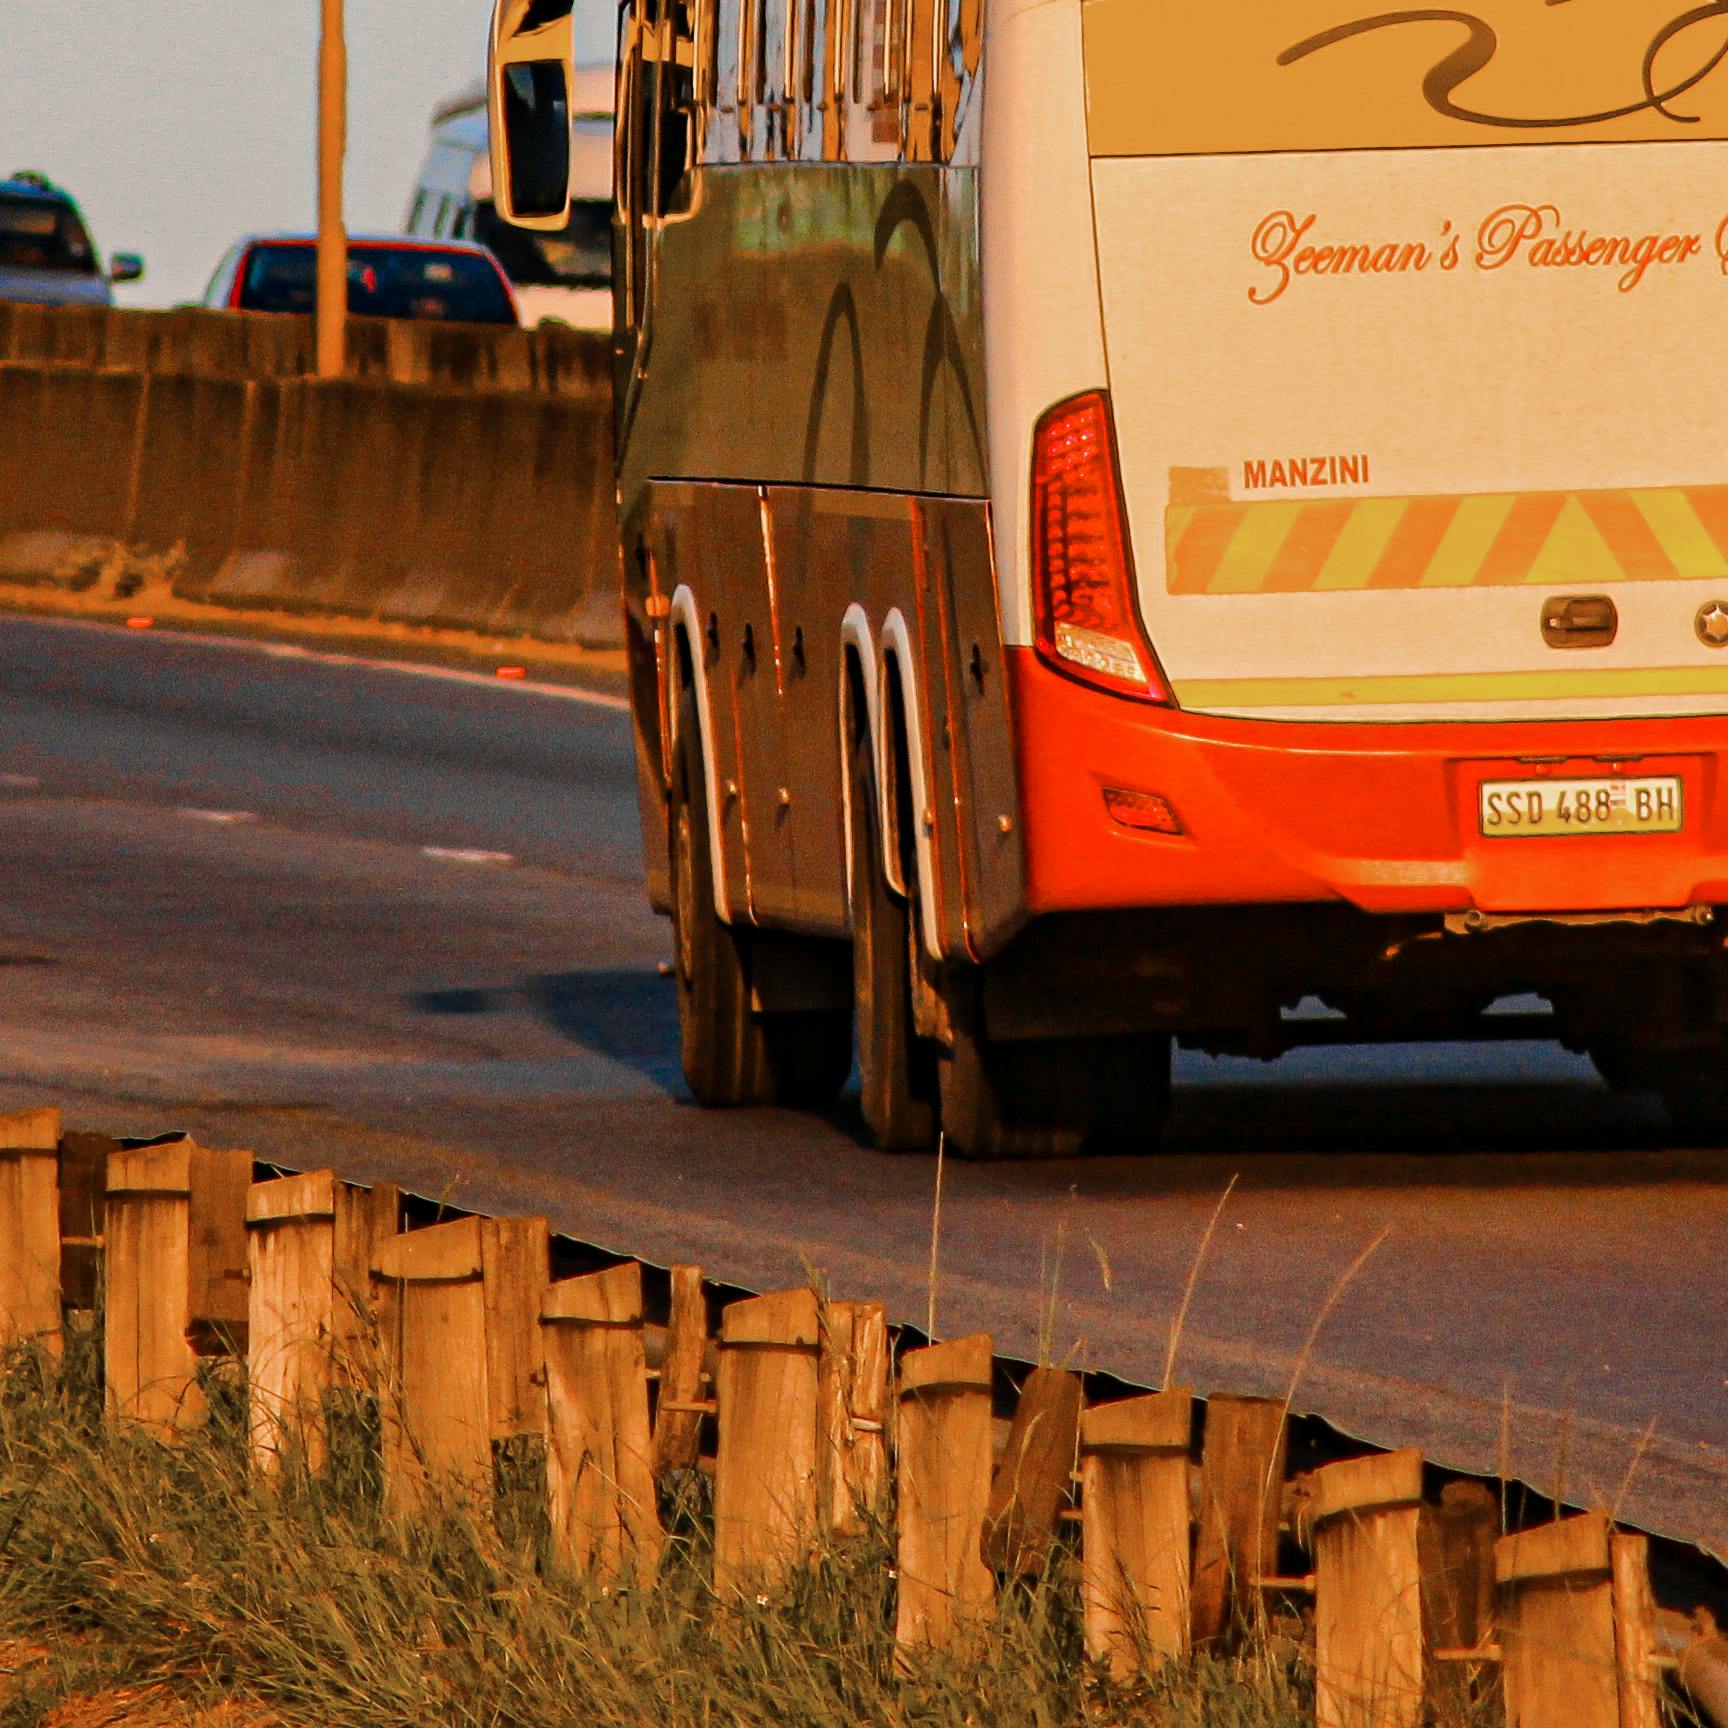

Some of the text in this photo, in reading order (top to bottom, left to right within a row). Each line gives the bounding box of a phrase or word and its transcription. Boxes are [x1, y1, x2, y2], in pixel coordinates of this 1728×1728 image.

[1248, 209, 1460, 305] Zeeman's
[1475, 204, 1702, 293] Passenger
[1243, 454, 1369, 489] MANZINI
[1487, 790, 1543, 825] SSD
[1556, 788, 1610, 823] 488
[1635, 787, 1673, 821] BH
